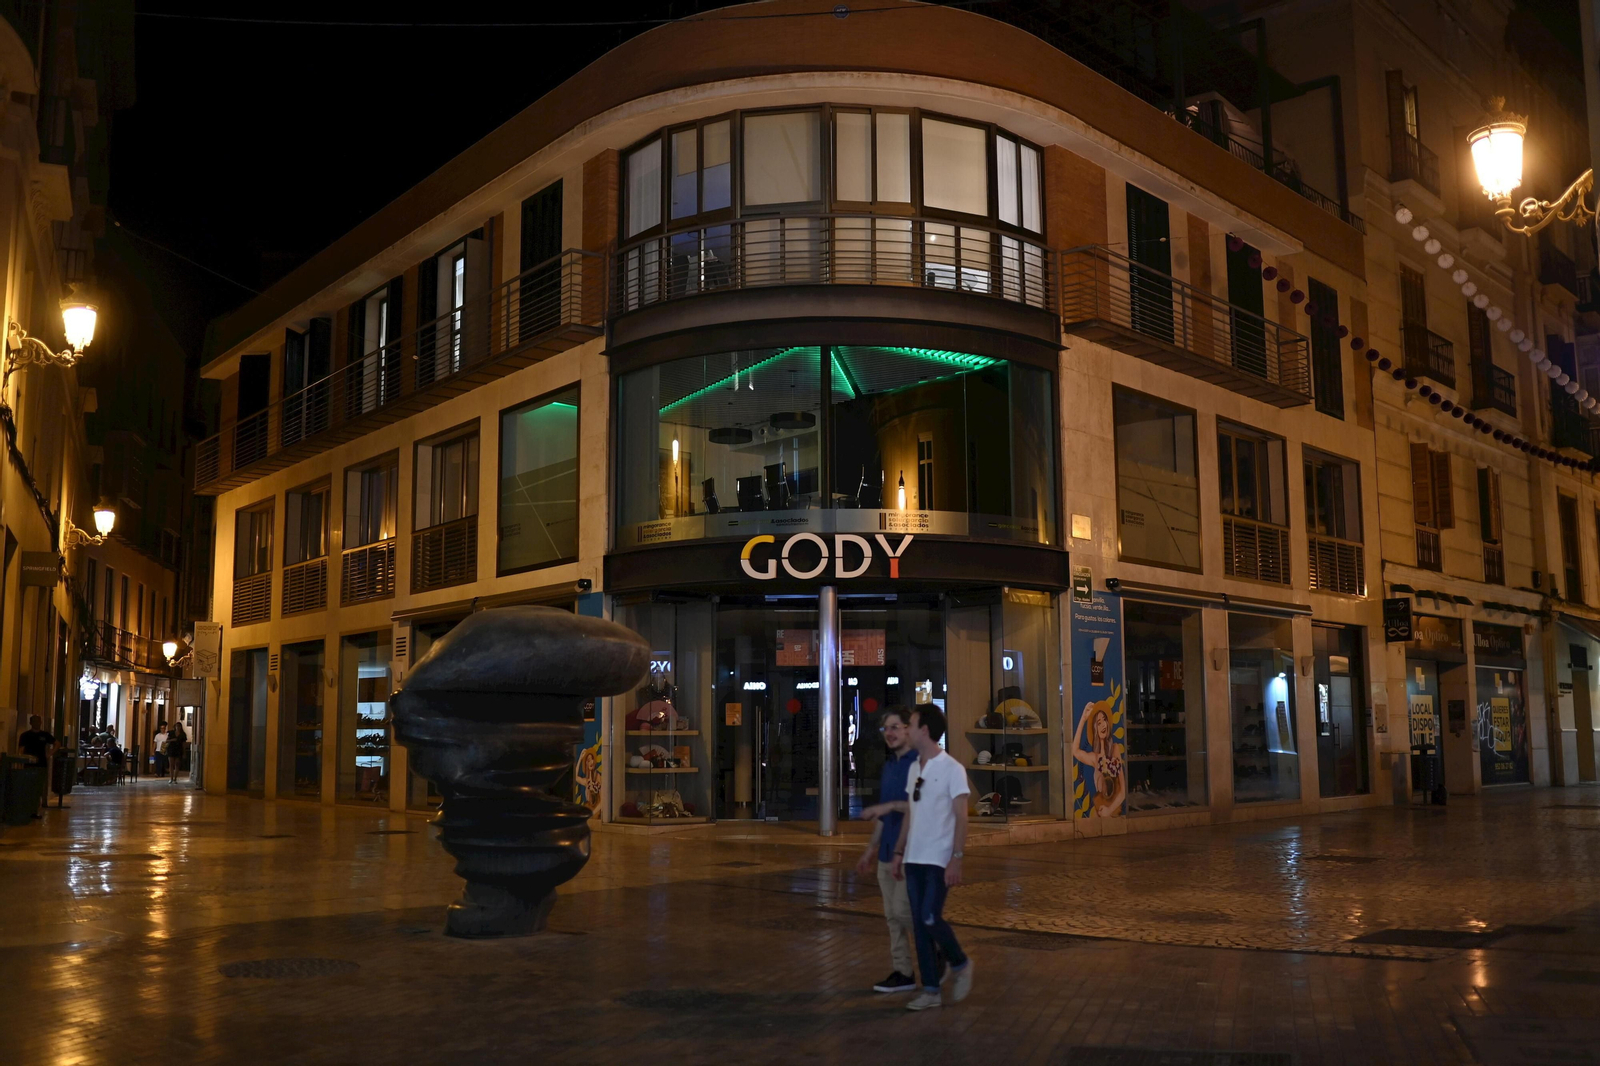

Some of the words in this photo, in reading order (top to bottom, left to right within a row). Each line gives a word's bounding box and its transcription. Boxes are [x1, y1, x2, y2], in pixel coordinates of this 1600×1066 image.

[741, 532, 915, 580] GODY
[1387, 619, 1409, 628] Ulloa
[1412, 703, 1432, 715] LOCAL
[1412, 717, 1433, 731] DISPO
[1493, 716, 1510, 728] ESTAR
